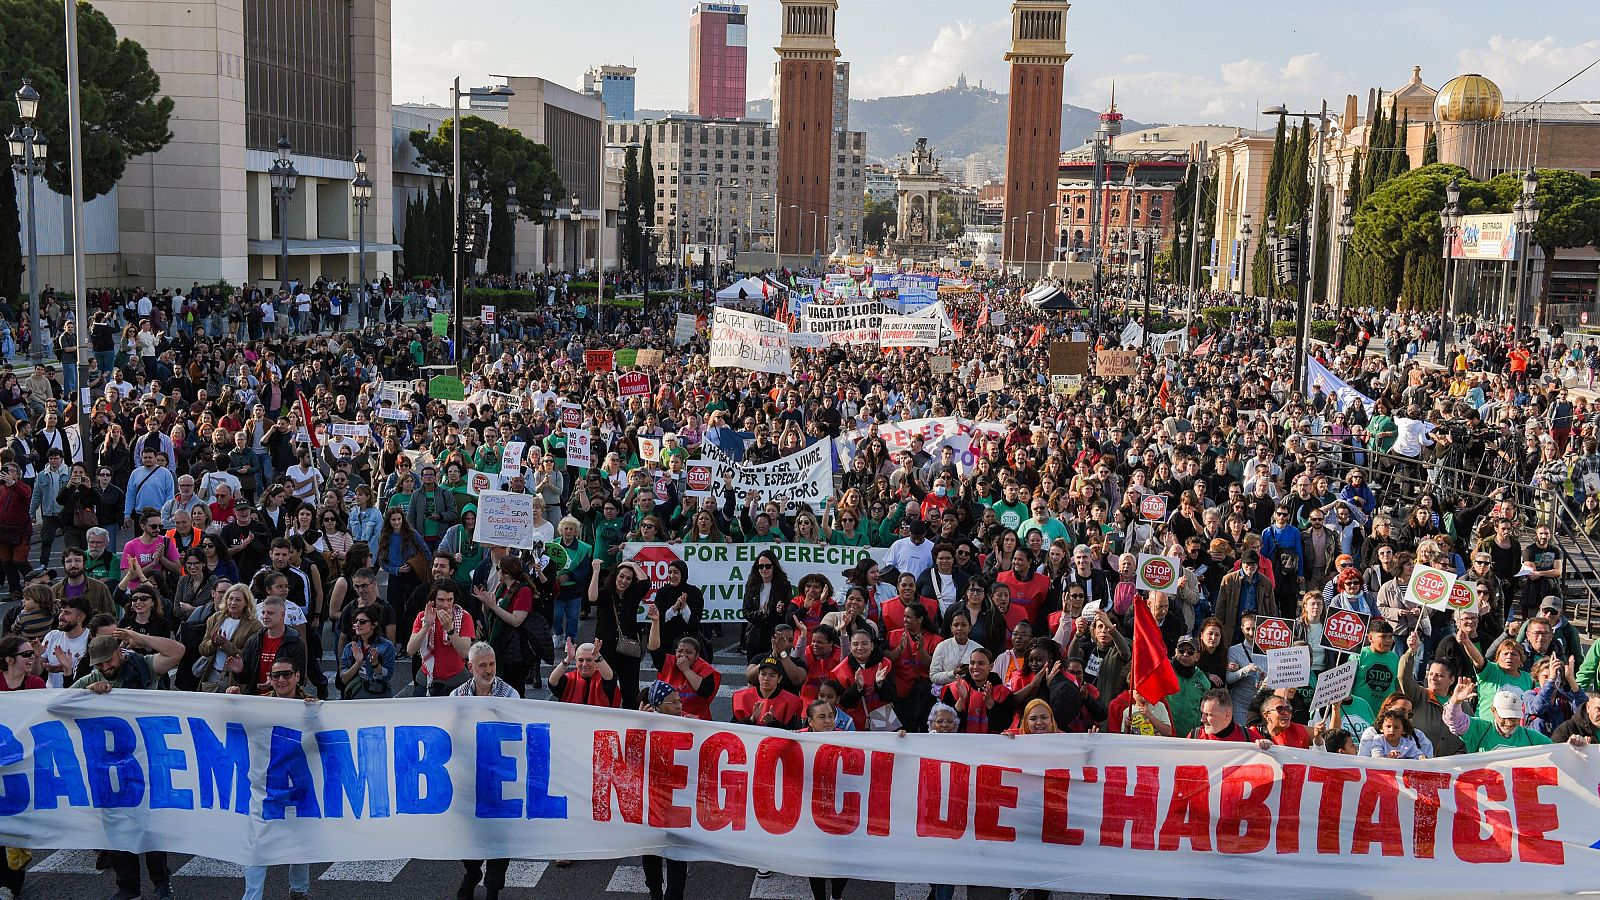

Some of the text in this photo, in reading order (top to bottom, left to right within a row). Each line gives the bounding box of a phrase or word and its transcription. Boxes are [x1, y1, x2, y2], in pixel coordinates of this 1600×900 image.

[707, 4, 732, 12] Allianz
[808, 306, 835, 319] VAGA
[836, 306, 850, 319] DE
[810, 319, 852, 333] CONTRA
[854, 318, 867, 330] LA
[588, 353, 610, 362] STOP
[712, 342, 784, 365] IMMOBILIARI
[625, 373, 642, 383] STOP
[563, 412, 580, 420] STOP
[569, 432, 577, 440] NO
[503, 457, 515, 465] PIRO
[569, 453, 589, 461] VAMPIRO
[689, 472, 710, 481] STOP
[738, 471, 760, 487] PER
[484, 496, 506, 504] CASA
[1143, 501, 1164, 510] STOP
[1002, 515, 1018, 523] STOP
[683, 545, 872, 566] POR EL DERECHO
[729, 566, 744, 581] A
[1146, 564, 1171, 575] STOP
[1419, 576, 1444, 590] STOP
[1329, 618, 1364, 636] STOP
[1259, 627, 1290, 641] STOP
[1327, 630, 1361, 642] DESAHUCIOS
[1258, 638, 1289, 647] DESAHUCIOS
[1323, 665, 1351, 682] 20.000
[1368, 669, 1391, 681] STOP
[1317, 674, 1354, 692] ALQUILERES
[1318, 684, 1347, 699] SOCIALES
[1314, 699, 1324, 707] EN
[1343, 722, 1368, 733] STOP
[262, 725, 454, 820] AMB
[474, 721, 568, 821] EL
[591, 728, 896, 837] NEGOCI
[1041, 764, 1565, 866] L'HABITATGE
